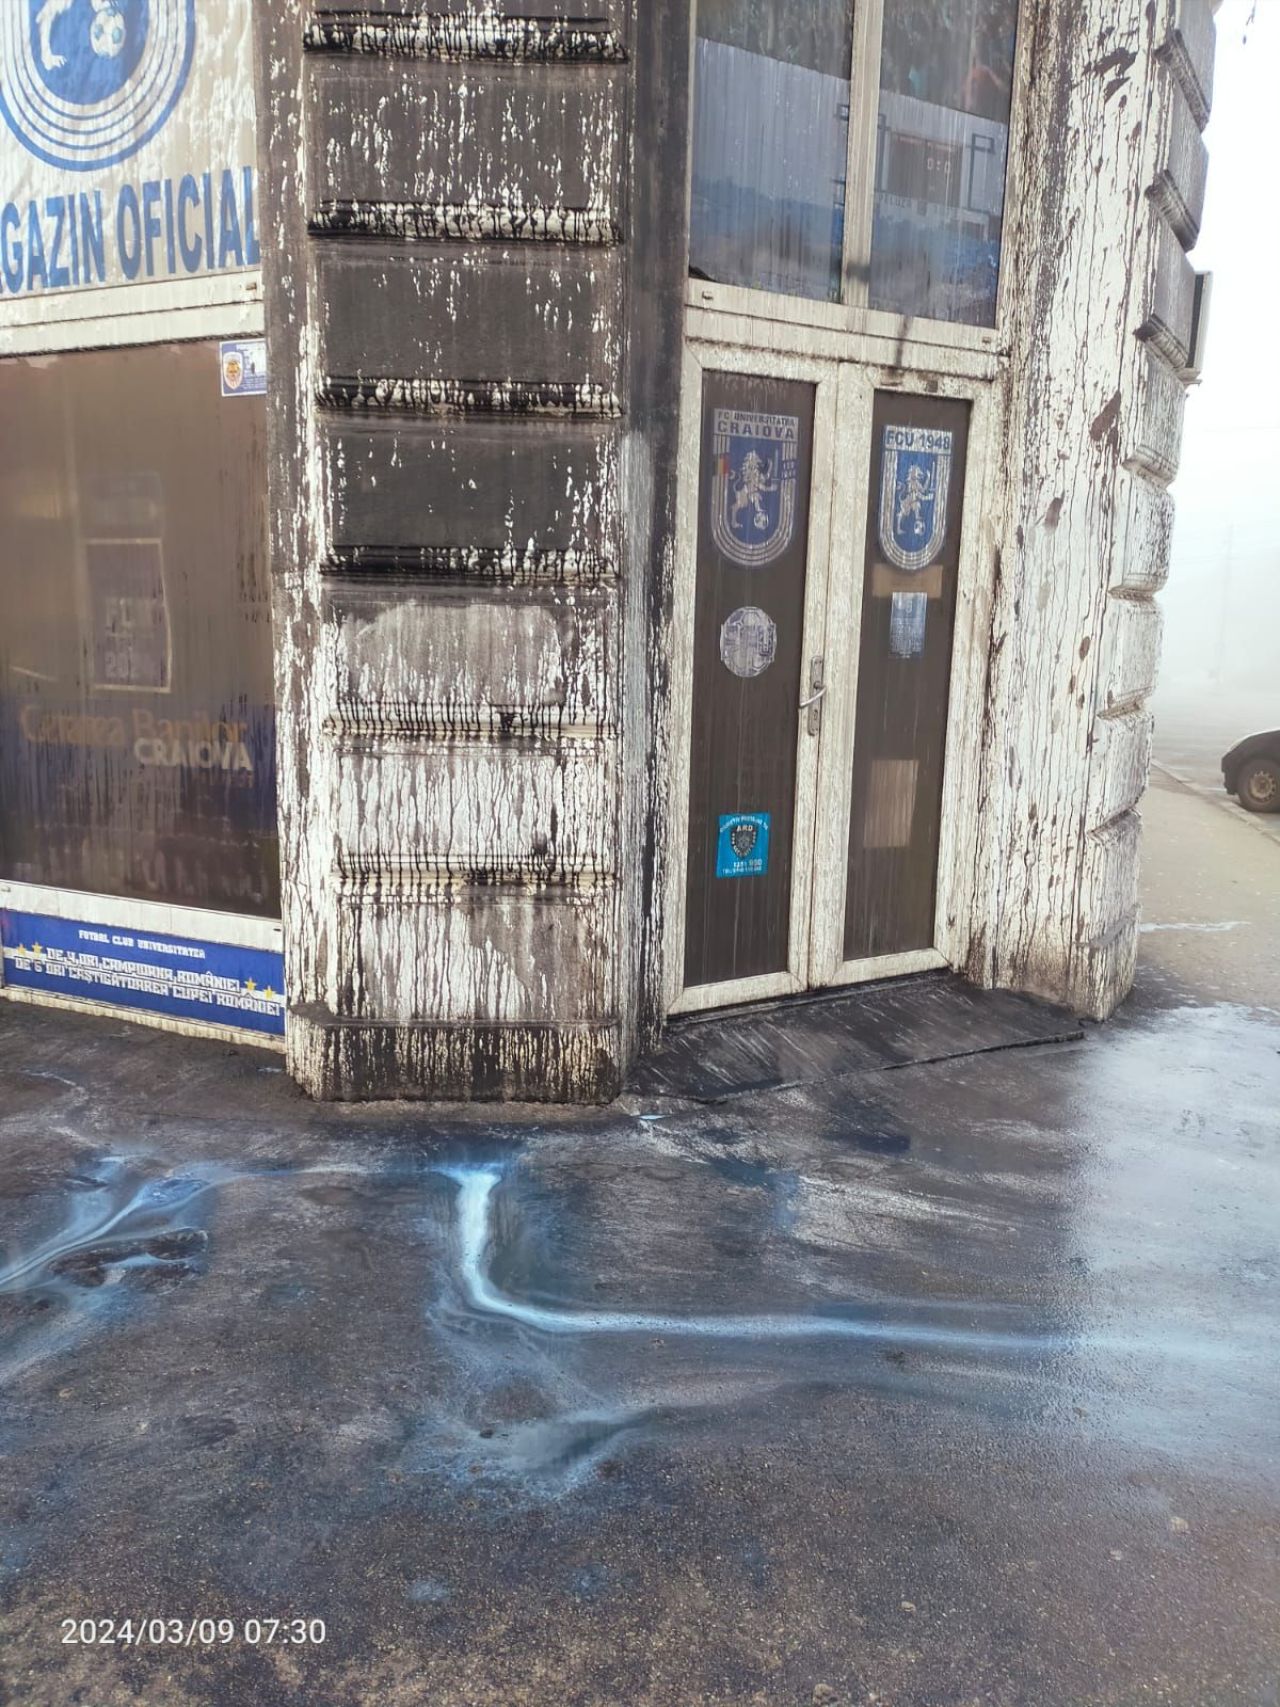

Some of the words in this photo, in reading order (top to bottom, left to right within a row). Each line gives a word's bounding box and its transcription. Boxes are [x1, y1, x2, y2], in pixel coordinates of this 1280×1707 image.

[0, 190, 106, 294] GAZIN
[116, 165, 262, 281] OFICIAL
[717, 421, 795, 439] CRAIOVA
[885, 430, 914, 447] FCU
[919, 433, 951, 450] 1948
[133, 737, 254, 770] CRAIOVA
[112, 935, 134, 948] CLUB
[137, 938, 206, 959] UNIVERSITATEA
[46, 947, 64, 961] DE
[79, 953, 99, 968] ORI
[177, 970, 240, 993] ROMÂNIEI
[15, 957, 32, 972] DE
[46, 962, 66, 977] ORI
[172, 985, 213, 1004] CUPEI
[217, 992, 280, 1017] ROMÂNIEI
